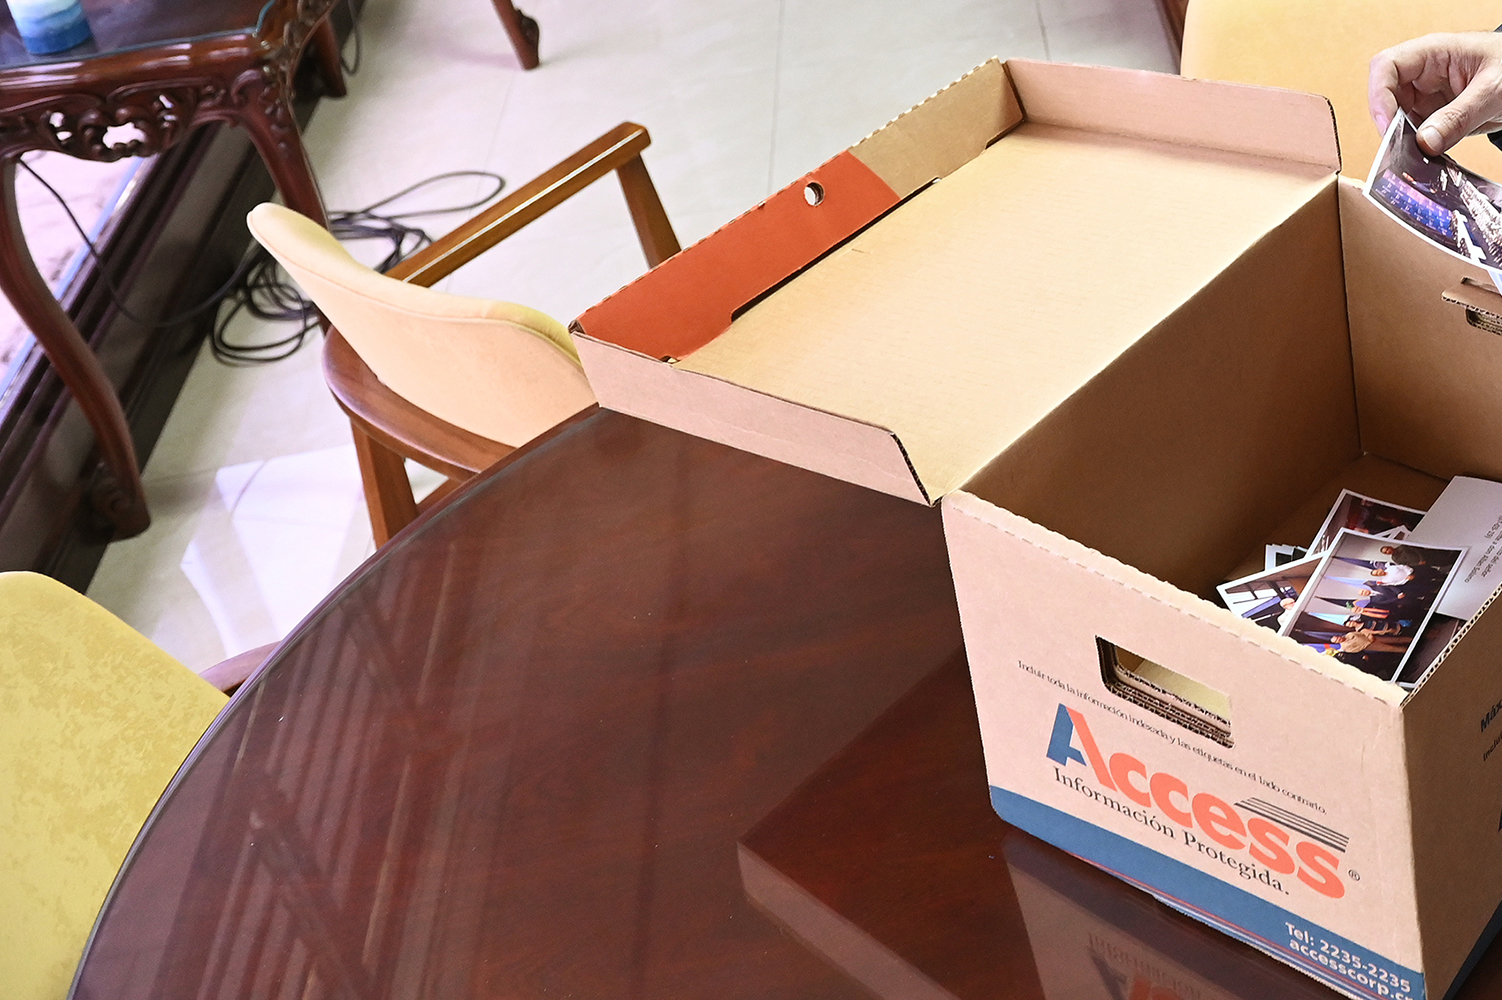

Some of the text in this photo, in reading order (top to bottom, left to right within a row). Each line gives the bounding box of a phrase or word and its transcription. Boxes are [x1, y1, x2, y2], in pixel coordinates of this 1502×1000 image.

[1017, 660, 1046, 680] Incluir
[1046, 675, 1066, 690] toda
[1066, 683, 1076, 695] la
[1076, 688, 1128, 720] información
[1128, 714, 1168, 739] indexada
[1177, 737, 1191, 751] las
[1192, 746, 1234, 771] etiquetas
[1234, 766, 1247, 777] en
[1248, 771, 1257, 782] el
[1258, 775, 1281, 793] lado
[1281, 788, 1328, 815] contrario.
[1481, 699, 1502, 733] Máx
[1046, 703, 1345, 899] Access
[1053, 766, 1290, 896] Información Protegida.
[1285, 922, 1411, 993] Tel: 2235-2235
